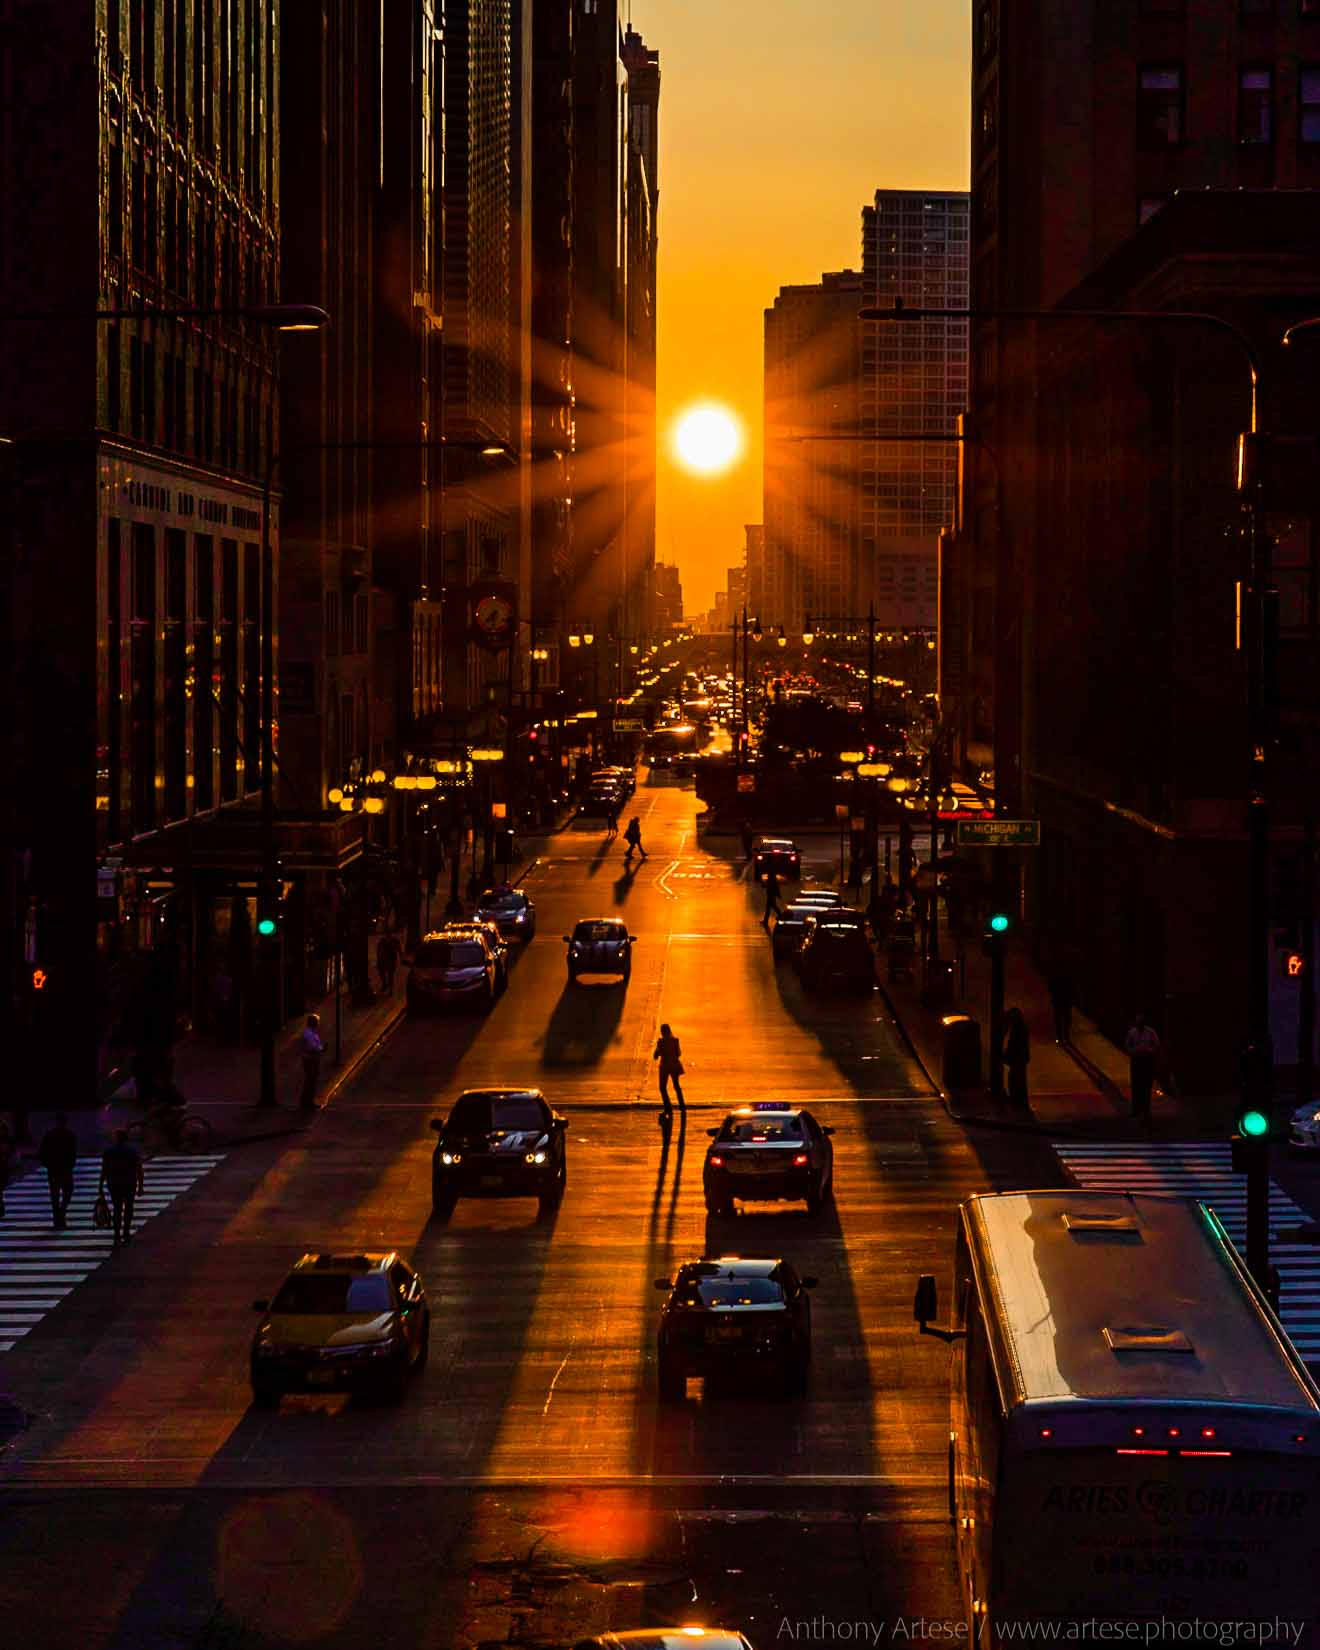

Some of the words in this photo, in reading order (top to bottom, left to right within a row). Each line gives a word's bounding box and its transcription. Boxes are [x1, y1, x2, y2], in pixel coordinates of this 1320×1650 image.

[974, 824, 1021, 834] MICHIGAN
[1041, 1484, 1130, 1513] ARIES
[1183, 1487, 1309, 1519] CHARTER
